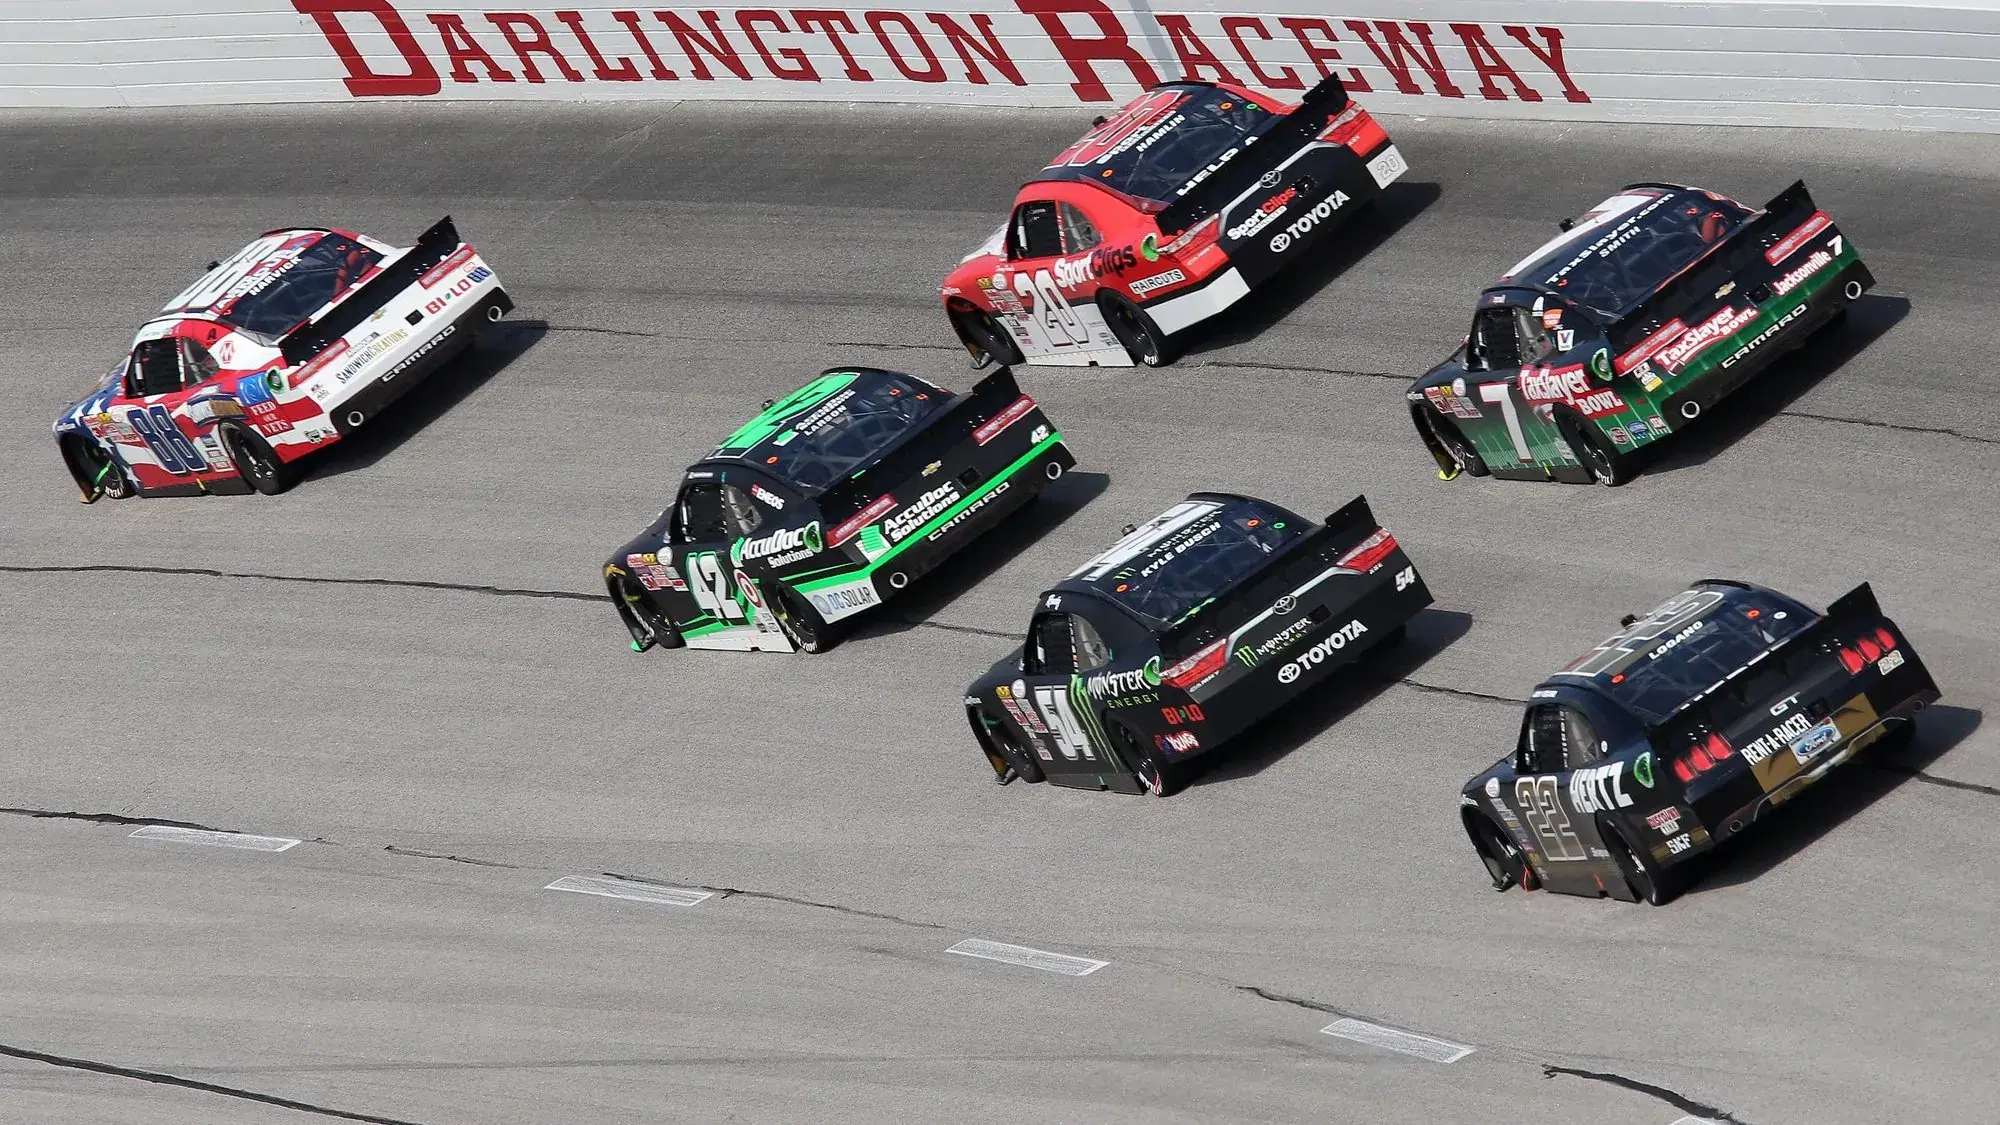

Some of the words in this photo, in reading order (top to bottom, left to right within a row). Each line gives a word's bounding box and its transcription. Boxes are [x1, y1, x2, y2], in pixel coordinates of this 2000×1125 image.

[293, 0, 1028, 96] DARLINGTON
[1016, 0, 1591, 103] RACEWAY
[1136, 114, 1185, 152] HAMLIN
[1376, 153, 1401, 180] 20
[1286, 190, 1350, 239] TOYOTA
[1599, 225, 1641, 258] SMITH
[1827, 235, 1842, 256] 7
[249, 256, 303, 296] HARVICK
[1131, 271, 1183, 292] HAIRCUTS
[1773, 250, 1832, 296] Jacksonville
[1014, 267, 1089, 348] 20
[382, 325, 456, 383] CAMARO
[1655, 307, 1734, 365] TaxSlayer
[1722, 304, 1807, 368] CAMARO
[1520, 368, 1591, 406] TaxSlayer
[1575, 390, 1625, 416] BOWL
[250, 401, 277, 416] FEED
[263, 420, 289, 434] VETS
[804, 405, 847, 435] LARSON
[1480, 383, 1533, 461] 7
[126, 403, 208, 474] 88
[757, 488, 785, 510] ENEOS
[883, 480, 955, 535] AccuDoc
[891, 490, 960, 542] Solutions
[928, 481, 1010, 542] CAMARO
[740, 527, 805, 561] AccuDoc
[767, 549, 814, 568] Solutions
[1141, 552, 1175, 577] KYLE
[1175, 521, 1221, 554] BUSCH
[686, 553, 745, 620] 42
[1395, 565, 1415, 592] 54
[1256, 618, 1312, 655] MONSTER
[1296, 619, 1369, 671] TOYOTA
[1648, 621, 1703, 660] LOGANO
[1087, 669, 1151, 700] MONSTER
[1107, 693, 1160, 708] ENERGY
[1770, 691, 1800, 716] GT
[1034, 685, 1096, 761] 54
[1569, 761, 1634, 813] HERTZ
[1515, 775, 1588, 861] 22
[1665, 833, 1691, 854] SKF
